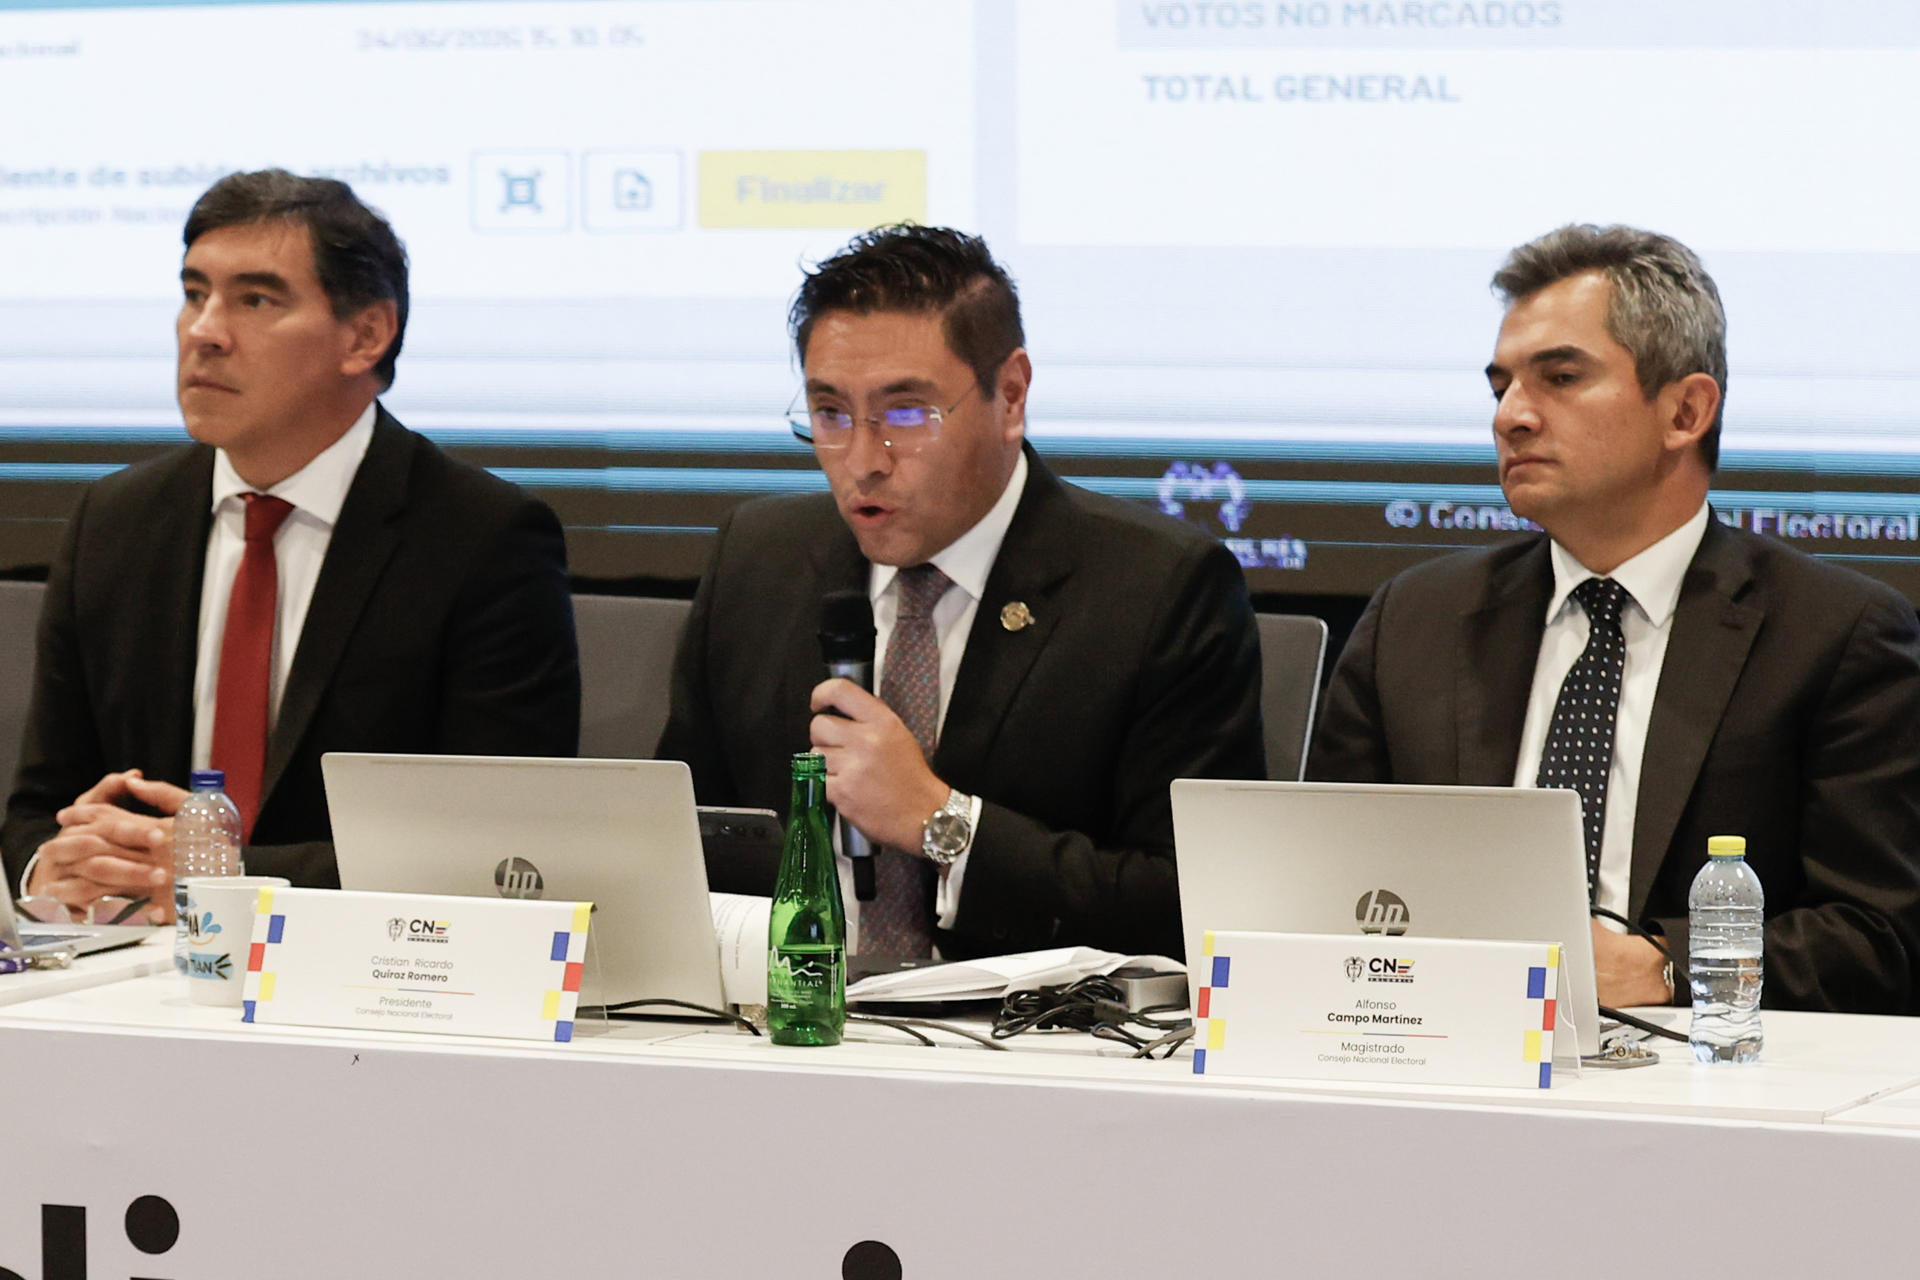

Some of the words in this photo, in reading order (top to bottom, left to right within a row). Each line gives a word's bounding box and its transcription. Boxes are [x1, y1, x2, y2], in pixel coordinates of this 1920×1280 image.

[1140, 0, 1264, 28] VOTOS
[1277, 0, 1330, 27] NO
[1342, 0, 1562, 27] MARCADOS
[1142, 74, 1263, 103] TOTAL
[1273, 73, 1461, 102] GENERAL
[737, 175, 887, 204] Finalizar
[502, 857, 538, 899] hp
[1363, 889, 1404, 936] hp
[410, 919, 451, 935] CNE
[370, 955, 410, 968] Cristian
[414, 957, 454, 970] Ricardo
[1368, 957, 1415, 975] CNE
[372, 968, 406, 981] Quiroz
[407, 971, 449, 983] Romero
[379, 996, 433, 1009] Presidente
[1355, 999, 1397, 1010] Alfonso
[355, 1007, 385, 1018] Consejo
[387, 1009, 419, 1018] Nacional
[421, 1011, 454, 1021] Electoral
[1327, 1012, 1370, 1026] Campo
[1341, 1041, 1405, 1055] Magistrado
[1317, 1053, 1351, 1065] Consejo
[1353, 1055, 1389, 1065] Nacional
[1391, 1056, 1426, 1066] Electoral
